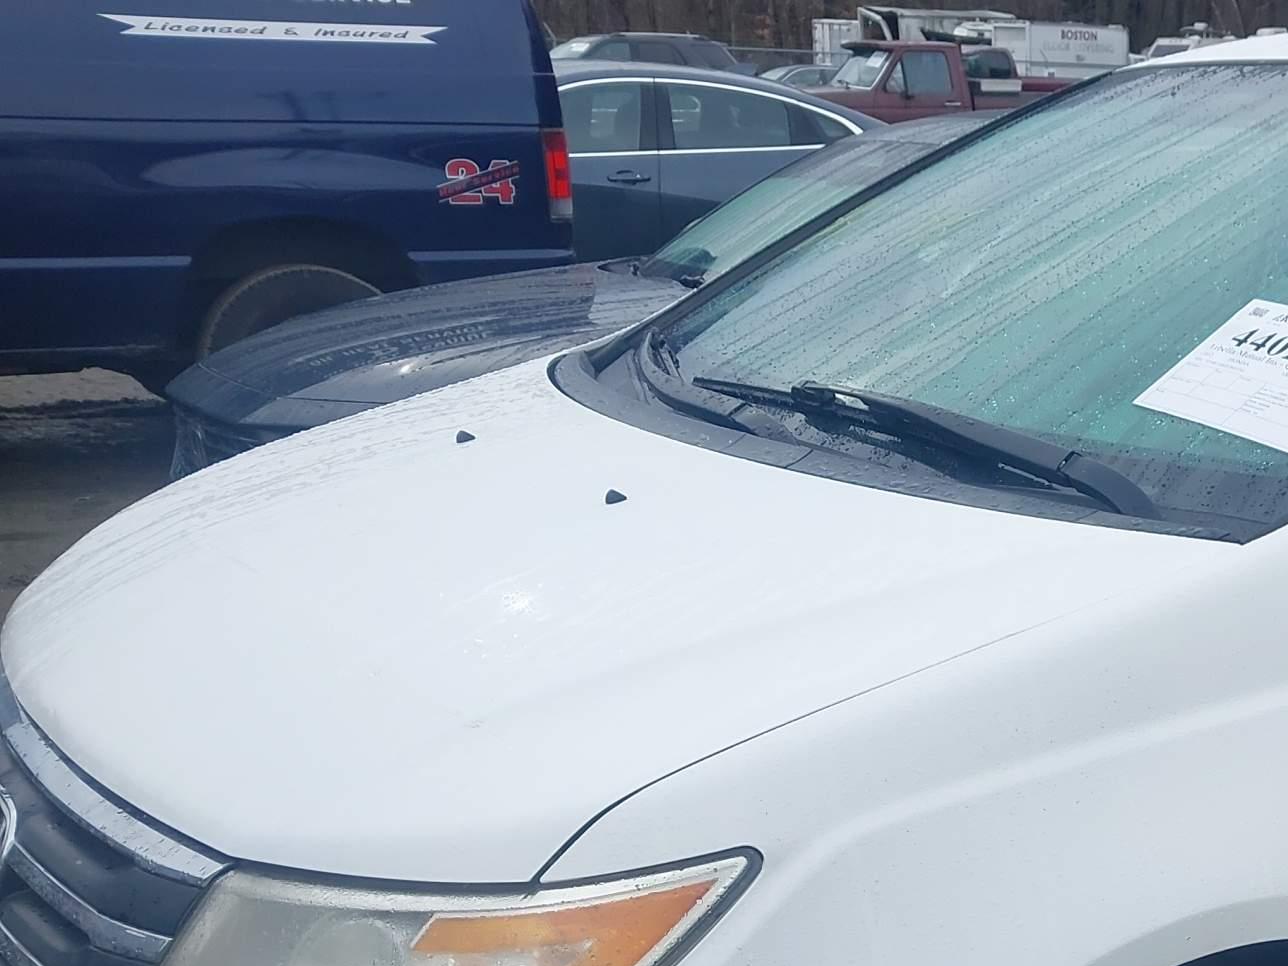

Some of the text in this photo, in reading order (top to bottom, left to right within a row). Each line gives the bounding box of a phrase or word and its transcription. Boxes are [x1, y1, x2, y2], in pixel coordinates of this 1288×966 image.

[144, 22, 409, 40] Licensed & Insured
[1060, 29, 1098, 41] BOSTON
[445, 158, 516, 205] 24
